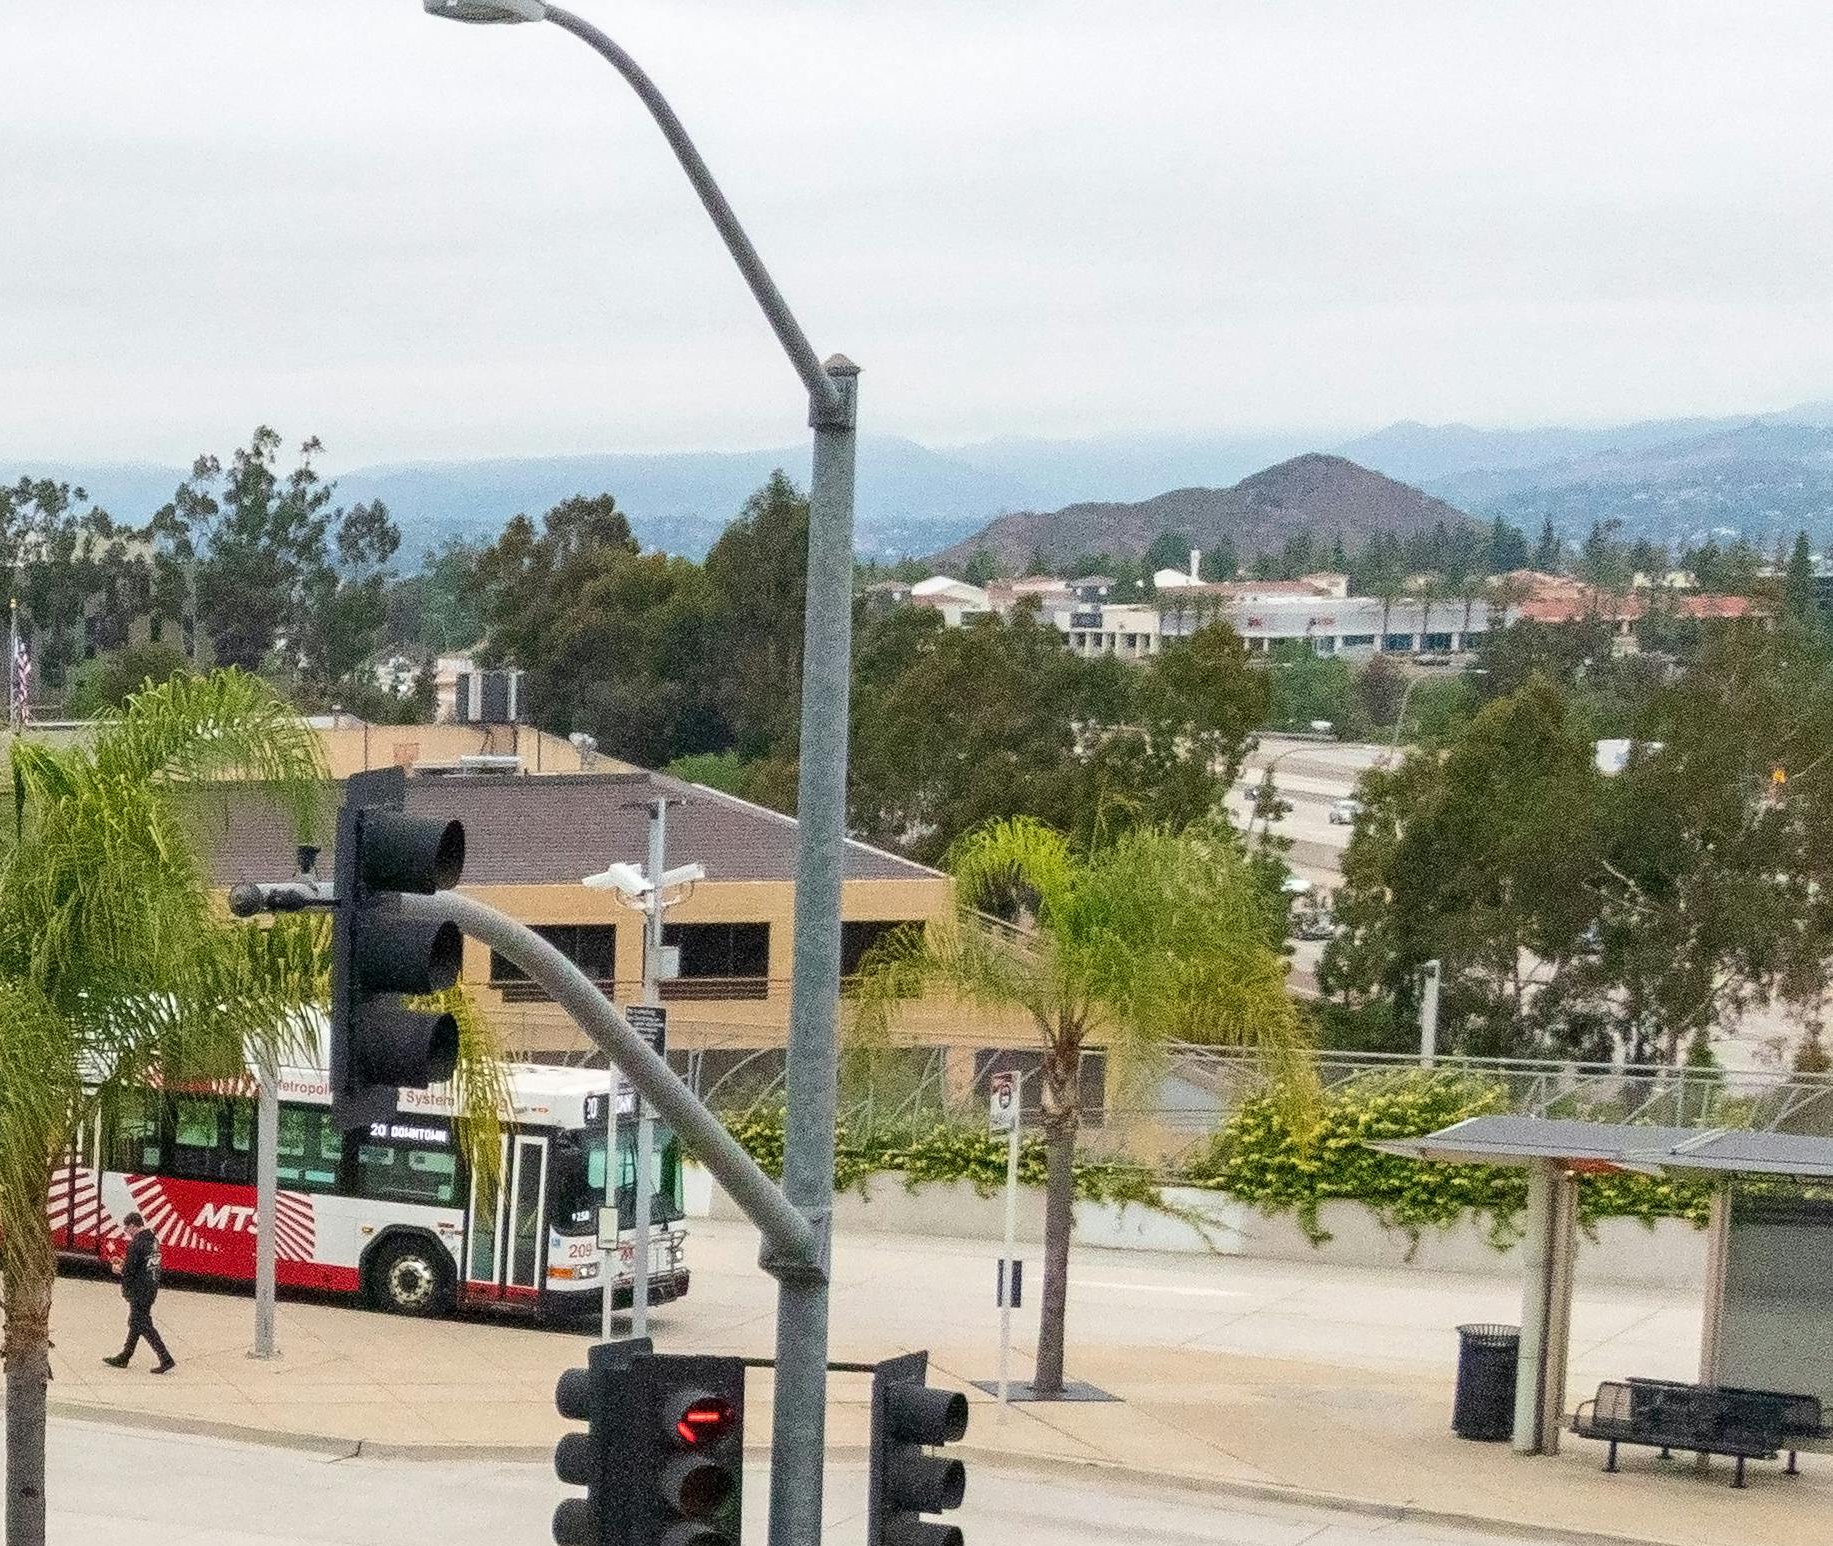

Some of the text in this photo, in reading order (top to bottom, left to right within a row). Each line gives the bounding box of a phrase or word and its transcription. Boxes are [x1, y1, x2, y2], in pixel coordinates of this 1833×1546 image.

[406, 1091, 455, 1107] System
[370, 1122, 448, 1143] 20 DOWNTOWN
